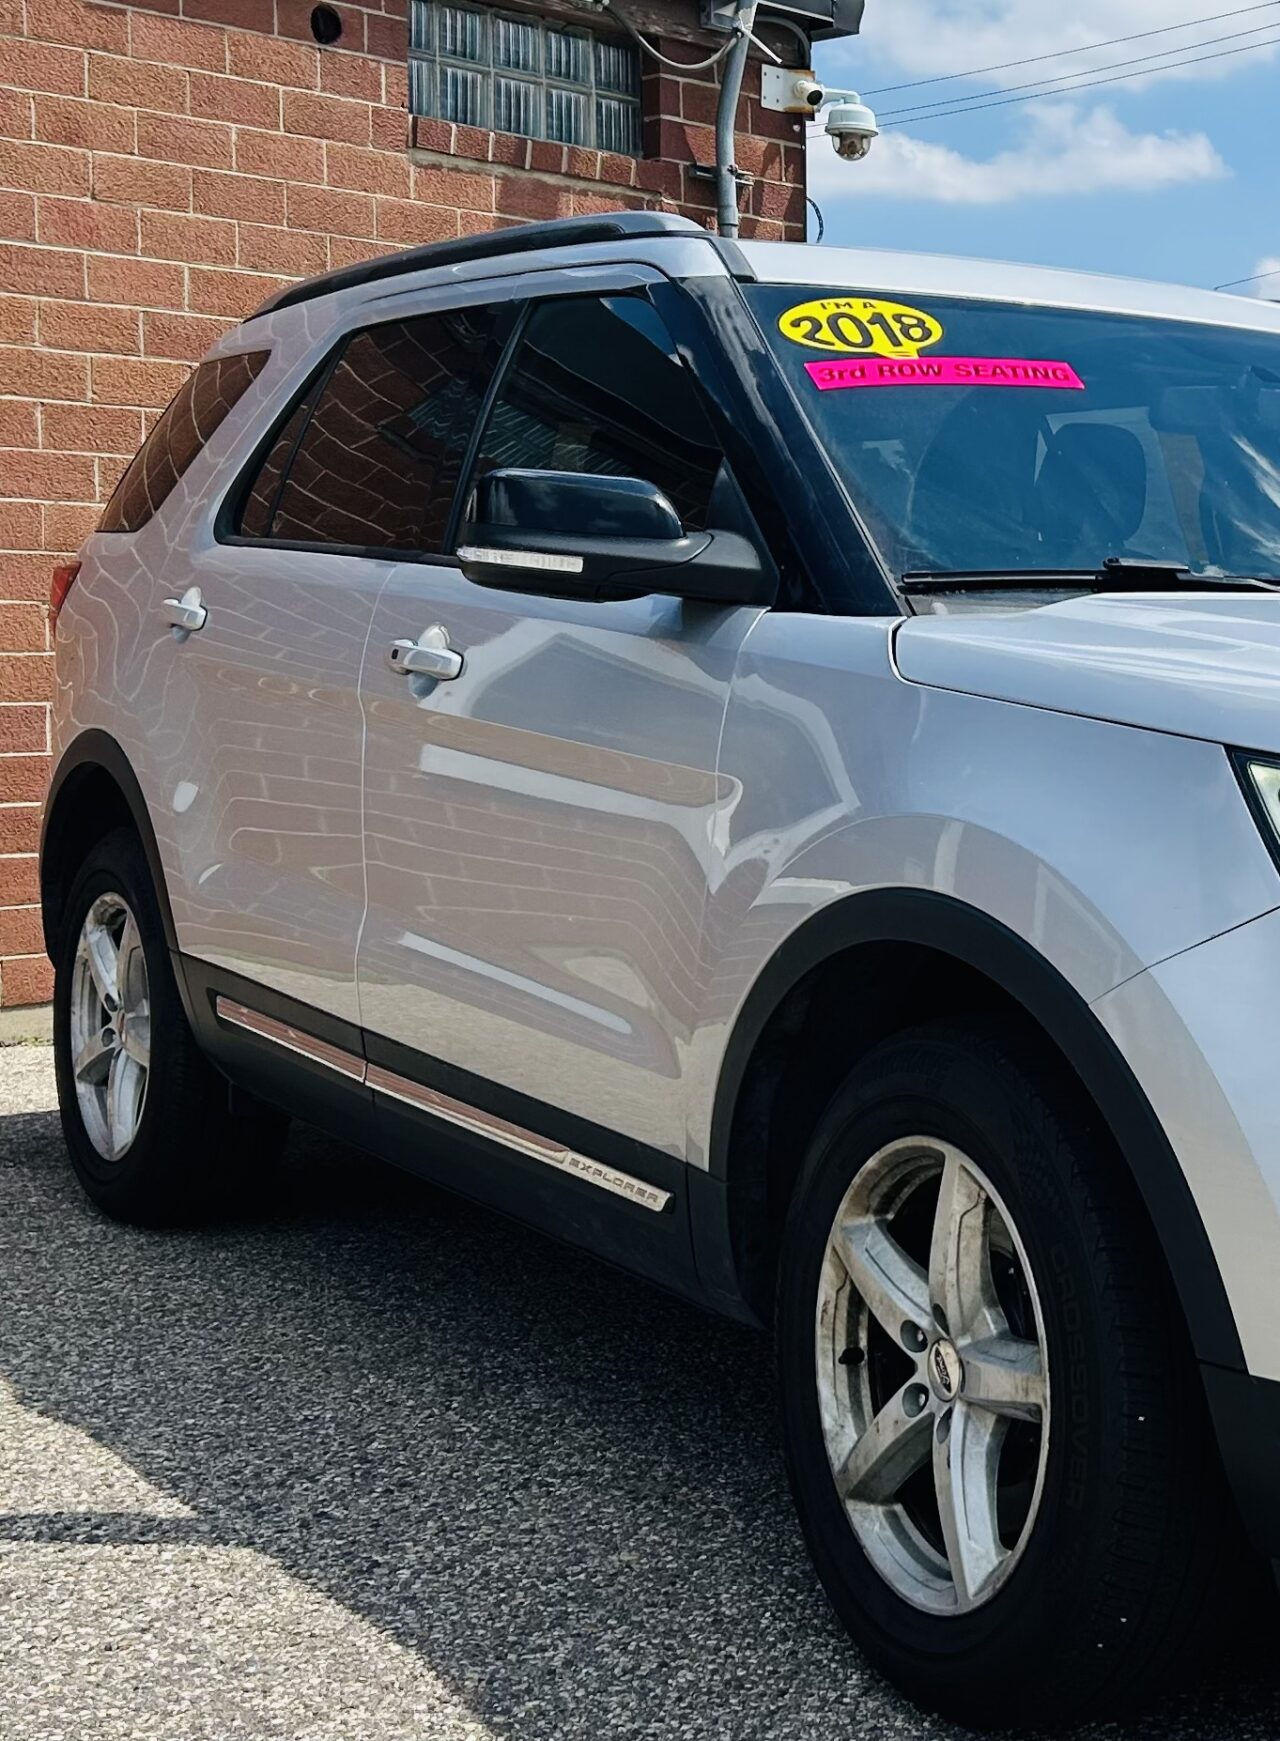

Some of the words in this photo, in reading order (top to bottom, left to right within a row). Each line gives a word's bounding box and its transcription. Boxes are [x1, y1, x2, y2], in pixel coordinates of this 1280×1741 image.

[820, 301, 853, 310] I'M
[862, 301, 877, 309] A
[789, 311, 933, 349] 2018
[818, 364, 867, 383] 3rd
[877, 363, 943, 379] ROW
[954, 363, 1071, 382] SEATING
[568, 1157, 660, 1203] EXPLORER
[1049, 1241, 1089, 1511] CROSSOVER
